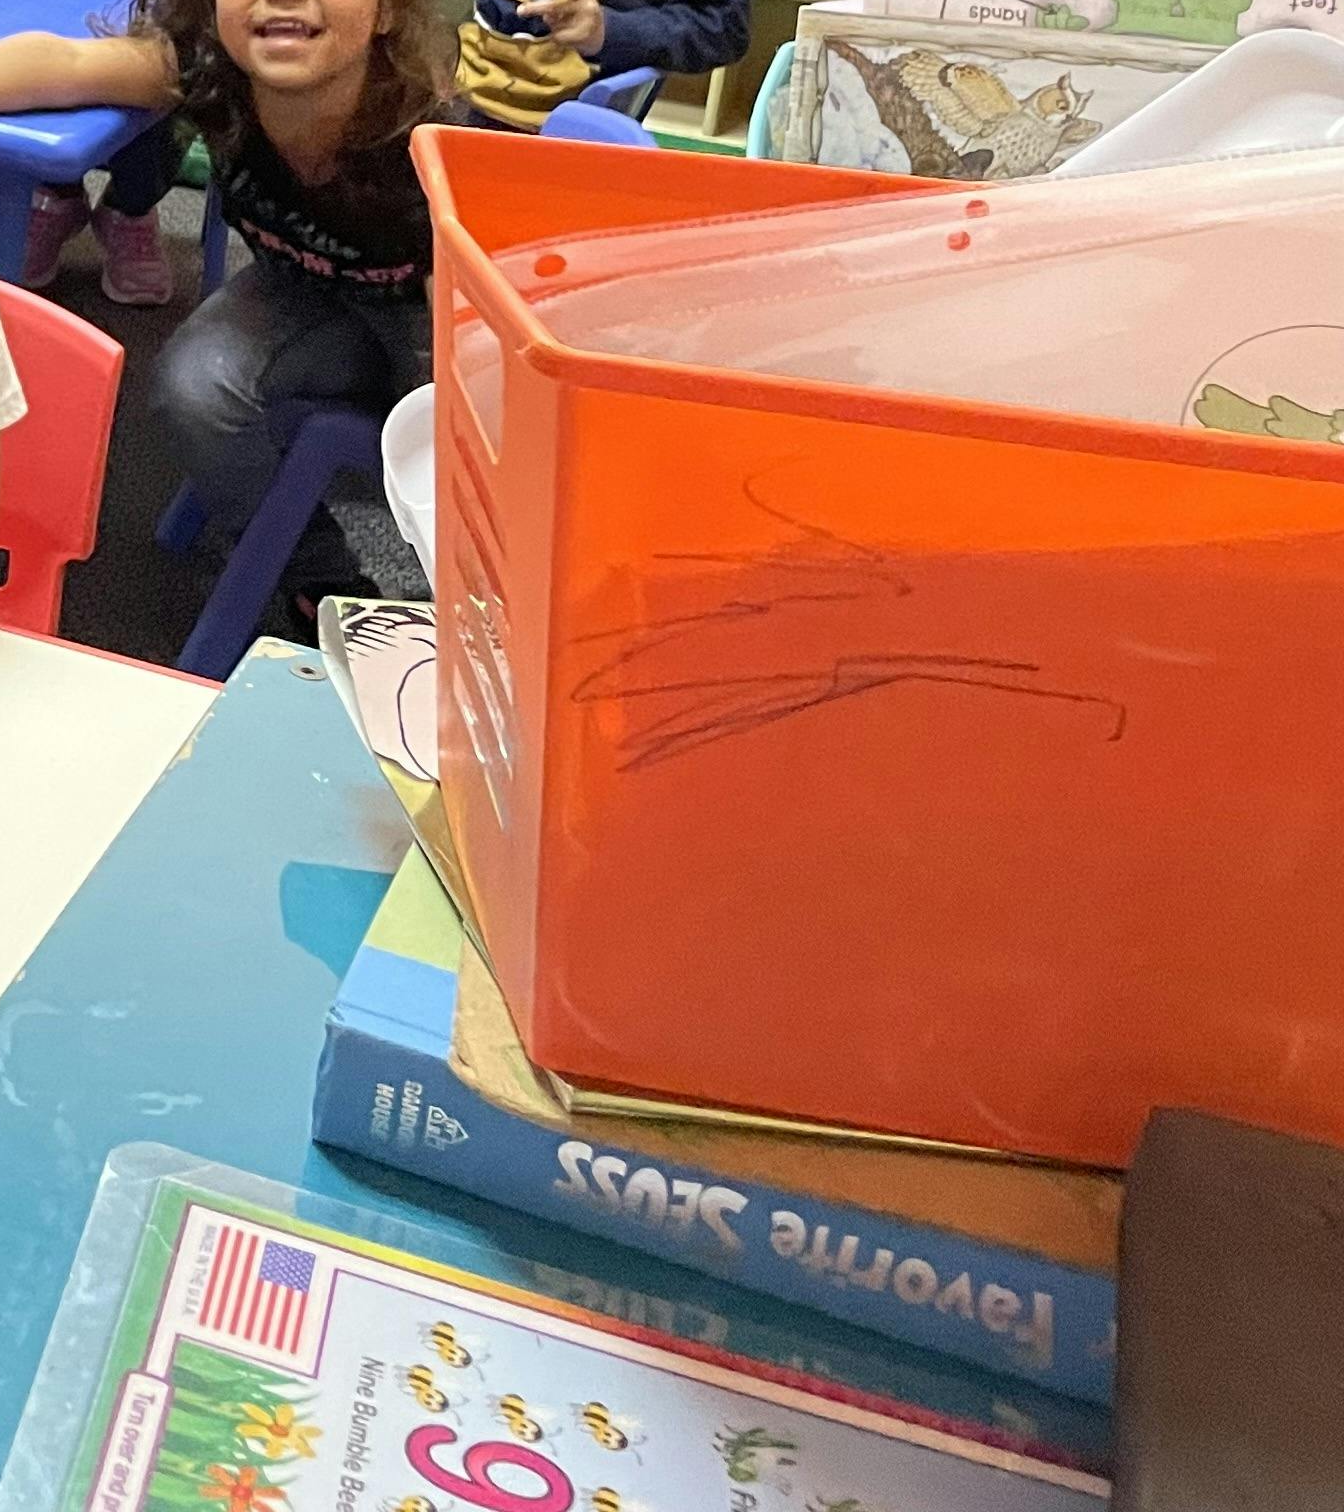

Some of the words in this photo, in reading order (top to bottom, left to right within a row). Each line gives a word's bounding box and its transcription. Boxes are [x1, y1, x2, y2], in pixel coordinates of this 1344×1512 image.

[968, 4, 1027, 23] hands
[553, 1140, 749, 1254] SEUSS
[770, 1209, 1055, 1371] Favorite
[356, 1356, 385, 1398] Nine
[343, 1401, 377, 1471] Bumble
